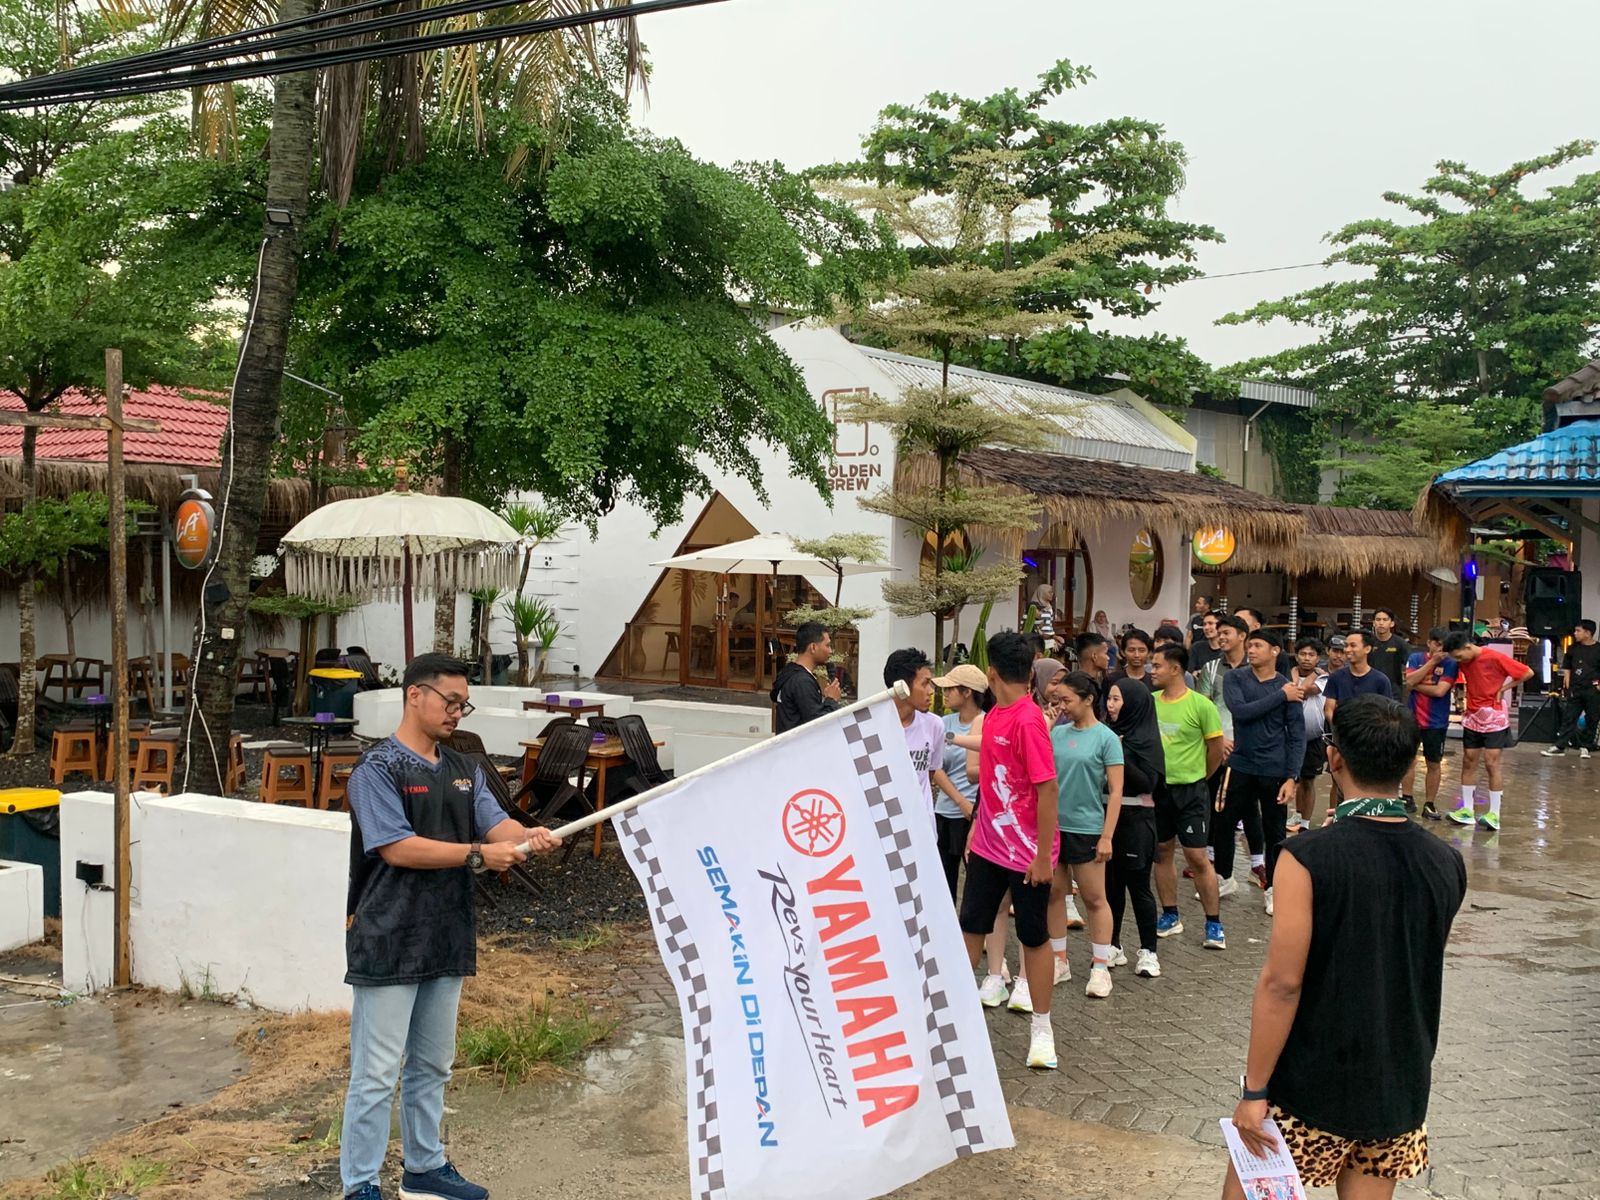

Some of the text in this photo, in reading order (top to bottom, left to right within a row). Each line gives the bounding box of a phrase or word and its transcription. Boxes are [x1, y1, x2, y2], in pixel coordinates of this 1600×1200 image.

[748, 1031, 778, 1147] DEPAN
[757, 862, 806, 957] Revs
[811, 1032, 848, 1109] Heart
[807, 854, 920, 1129] YAMAHA
